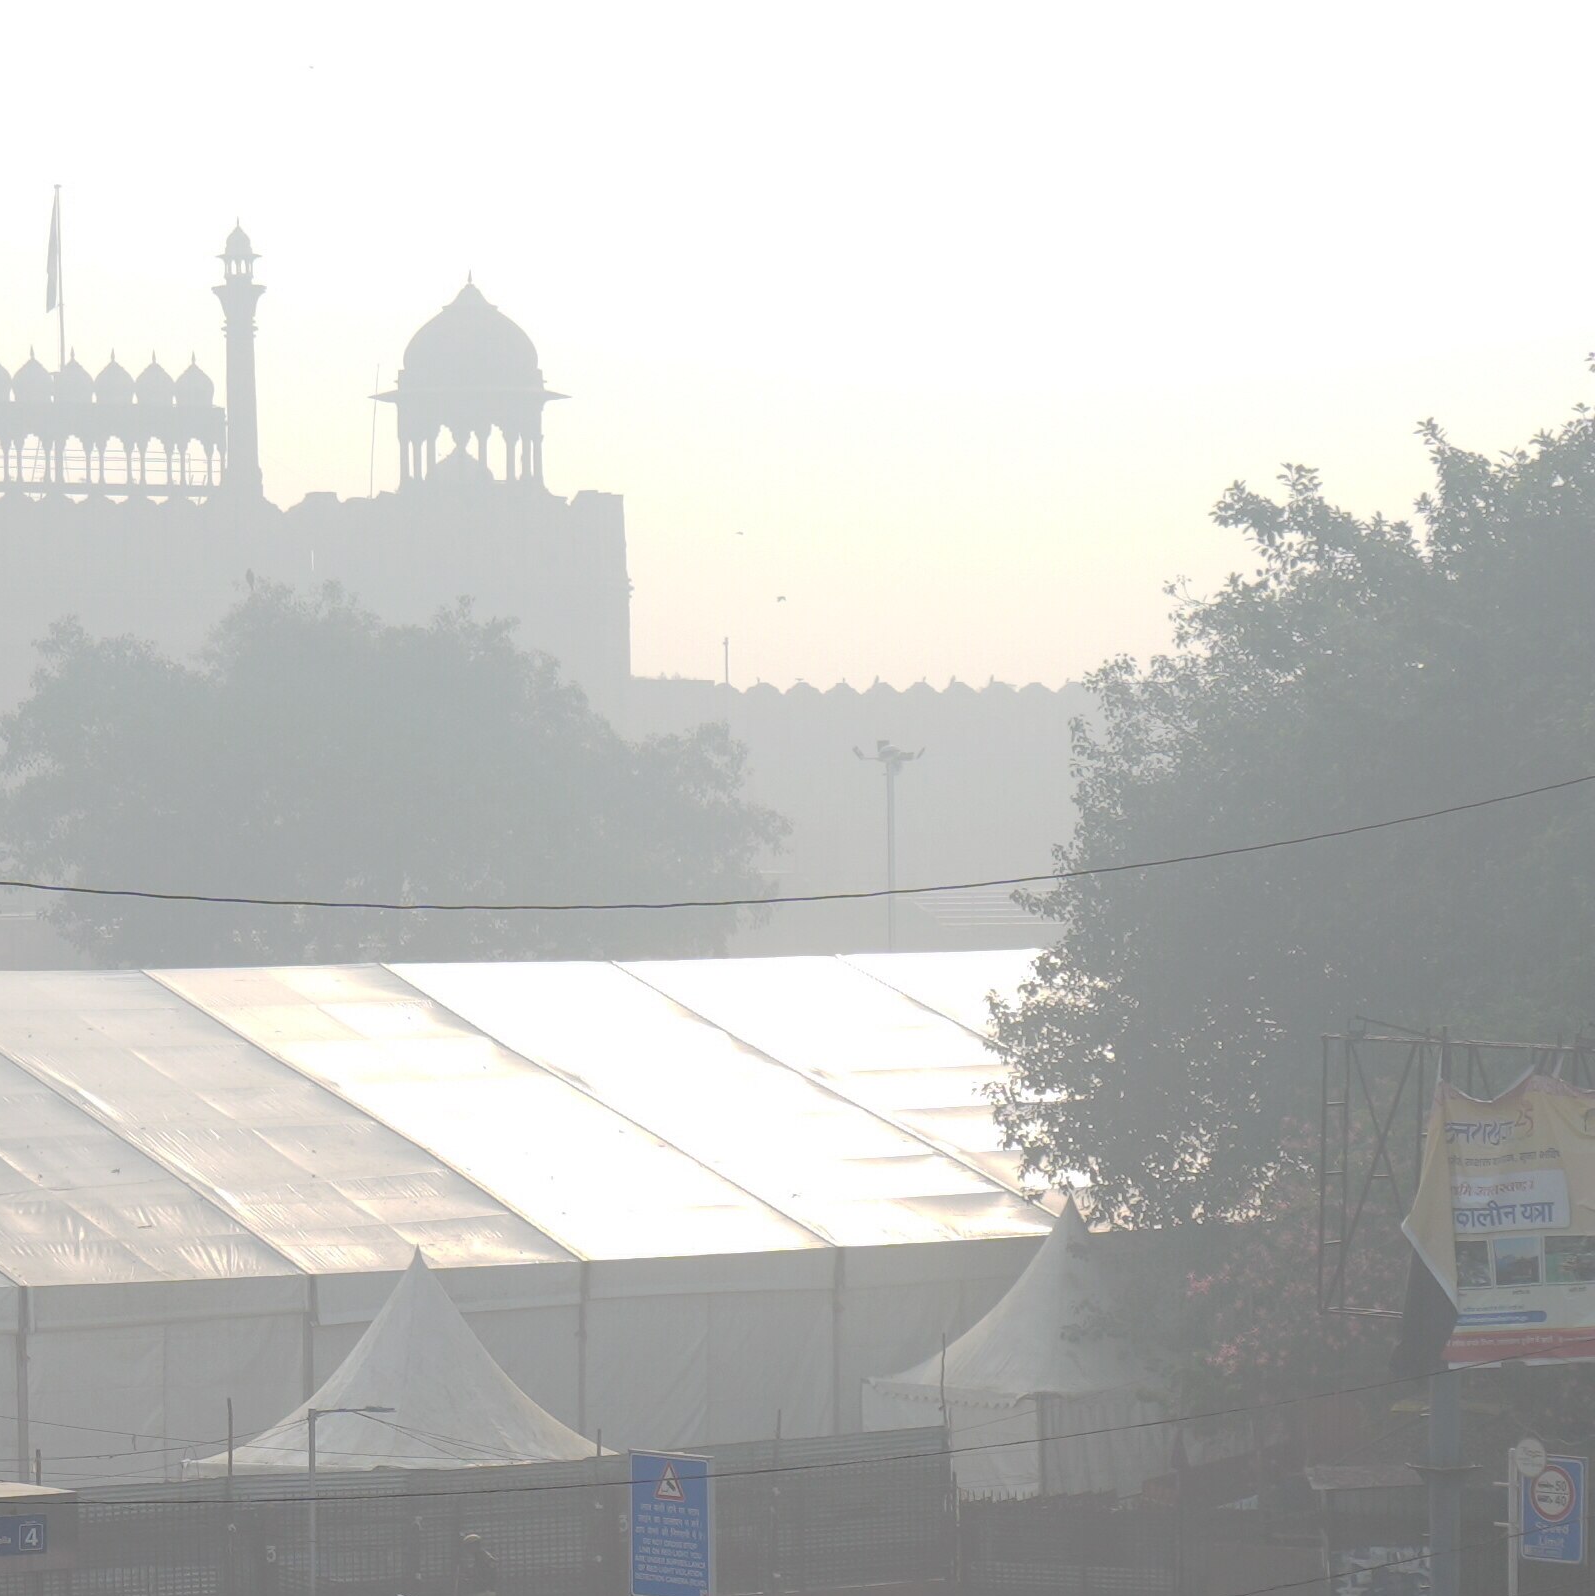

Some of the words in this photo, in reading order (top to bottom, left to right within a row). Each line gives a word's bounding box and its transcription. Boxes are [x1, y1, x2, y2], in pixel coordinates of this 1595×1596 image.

[1555, 1480, 1567, 1492] 50
[1555, 1495, 1567, 1507] 40
[24, 1528, 39, 1547] 4
